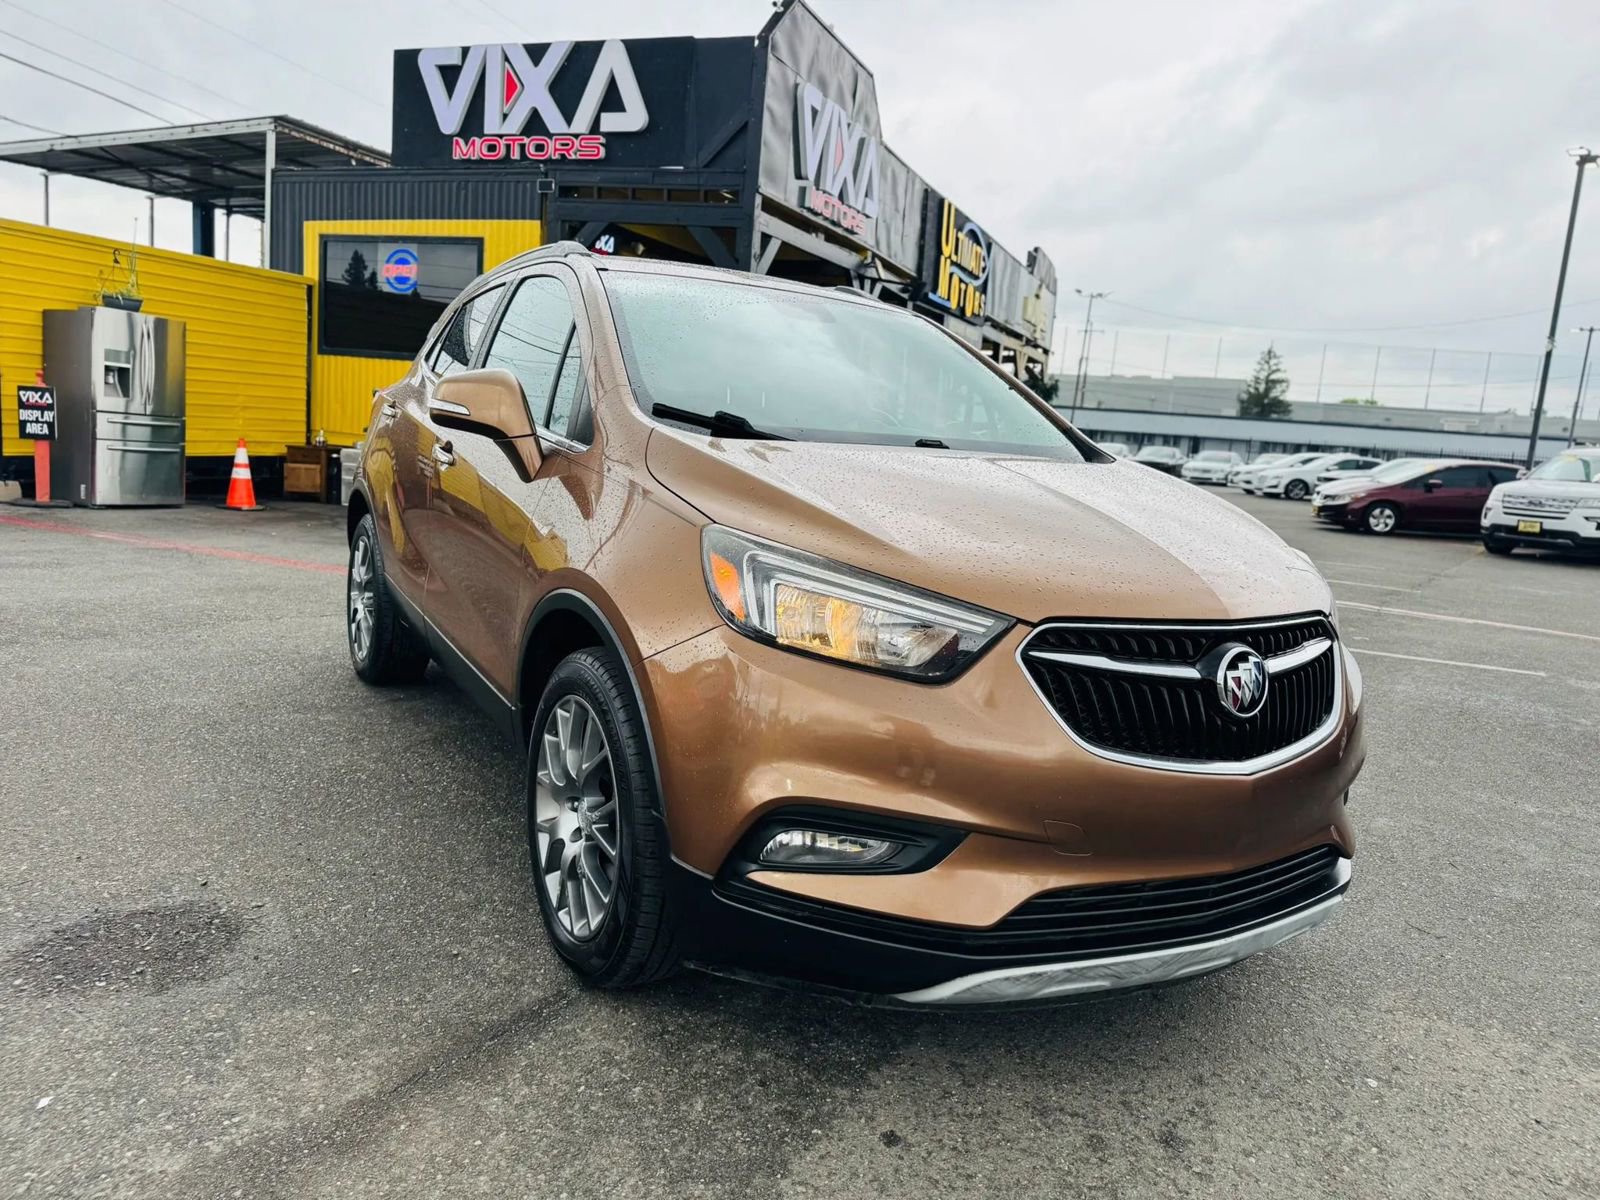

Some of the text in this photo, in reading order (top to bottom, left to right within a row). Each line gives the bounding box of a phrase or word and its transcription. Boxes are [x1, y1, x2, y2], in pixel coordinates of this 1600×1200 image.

[418, 39, 649, 135] VIXA
[452, 135, 606, 161] MOTORS
[800, 83, 879, 218] VIXA
[811, 189, 866, 235] MOTORS
[938, 255, 985, 317] MOTORS
[19, 390, 53, 403] VIXA
[19, 409, 54, 422] DISPLAY
[26, 423, 49, 435] AREA
